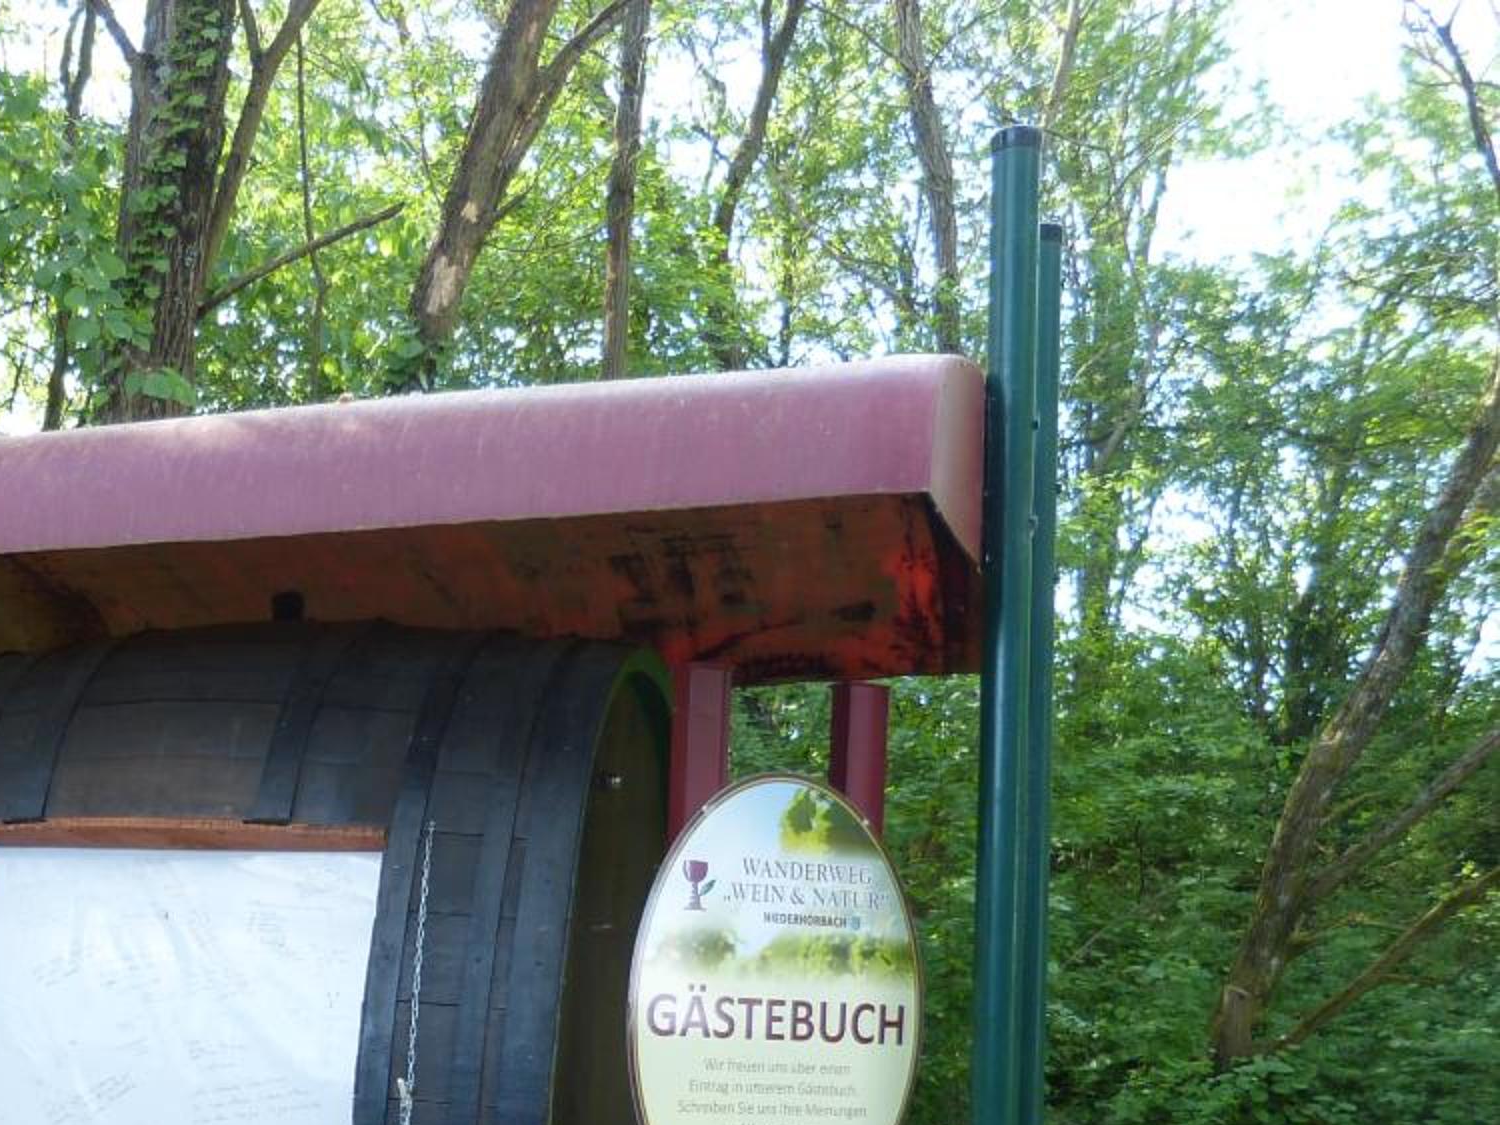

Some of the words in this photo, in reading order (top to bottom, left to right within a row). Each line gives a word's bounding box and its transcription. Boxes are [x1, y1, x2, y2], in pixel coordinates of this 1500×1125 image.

[742, 857, 872, 885] WANDERWEG
[789, 891, 806, 906] &
[763, 911, 848, 928] NIEDERHORBACH
[647, 983, 905, 1045] GÄSTEBUCH
[703, 1058, 723, 1073] Wir
[726, 1057, 766, 1074] freuen
[791, 1060, 816, 1075] über
[689, 1079, 729, 1096] Eintrag
[732, 1080, 743, 1093] in
[745, 1083, 794, 1096] unserem
[677, 1100, 735, 1114] Schreiben
[738, 1101, 754, 1115] Sie
[756, 1104, 777, 1115] uns
[779, 1102, 801, 1116] Ihre
[804, 1104, 867, 1120] Meinungen
